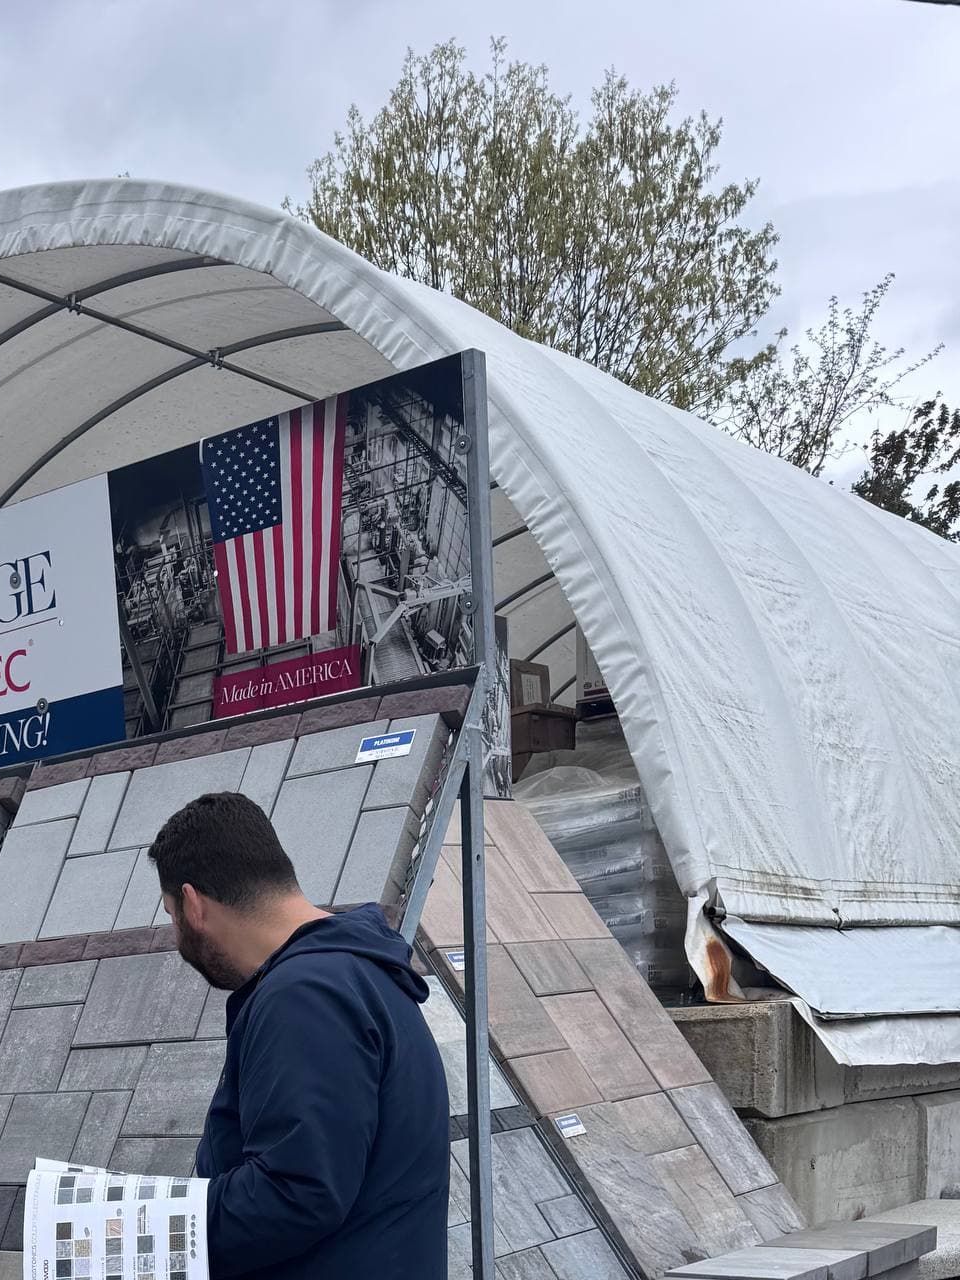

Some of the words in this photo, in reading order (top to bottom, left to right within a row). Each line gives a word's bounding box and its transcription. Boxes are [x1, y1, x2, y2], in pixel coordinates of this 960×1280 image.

[221, 681, 258, 705] Made
[260, 678, 272, 695] in
[275, 658, 353, 692] AMERICA
[373, 737, 401, 747] PLATINUM
